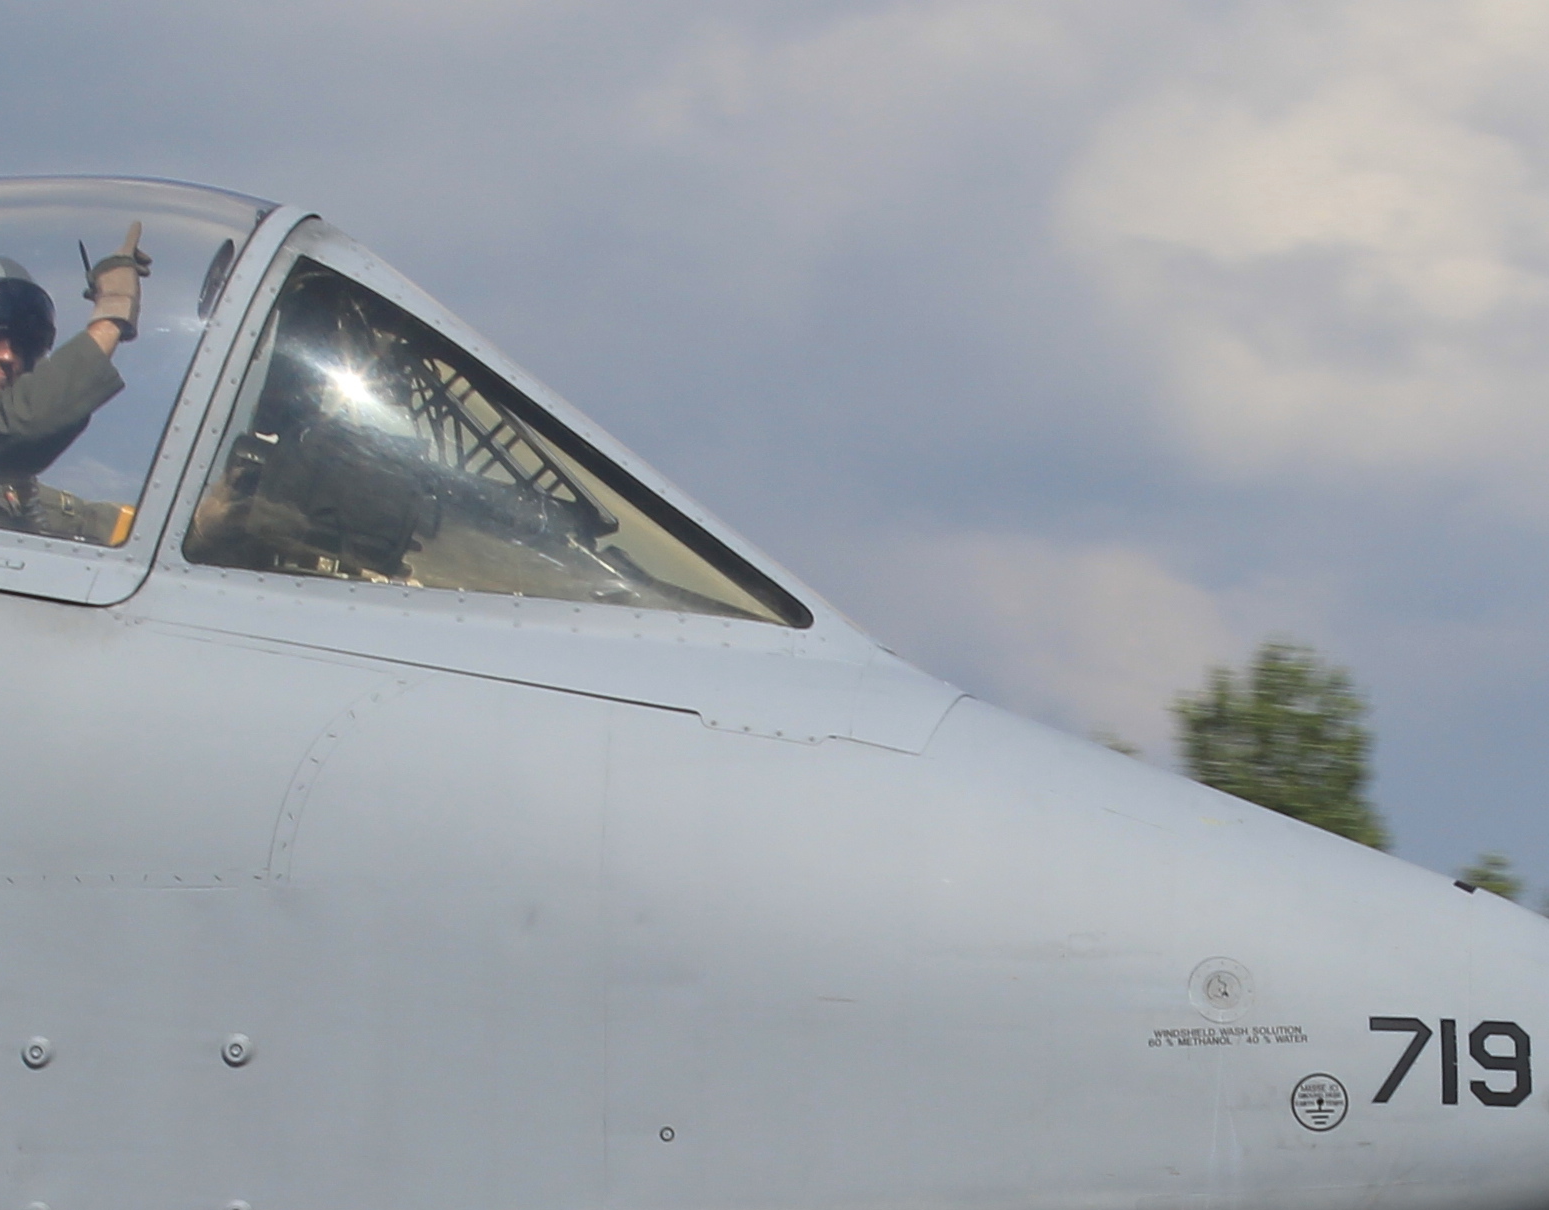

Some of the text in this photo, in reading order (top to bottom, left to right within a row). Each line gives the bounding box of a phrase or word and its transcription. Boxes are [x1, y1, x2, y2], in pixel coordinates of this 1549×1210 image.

[1153, 1025, 1302, 1039] WINDSHIELD WASH SOLUTION
[1177, 1036, 1233, 1046] METHANOL
[1245, 1035, 1260, 1045] 40
[1274, 1034, 1309, 1044] WATER
[1369, 1016, 1532, 1107] 719
